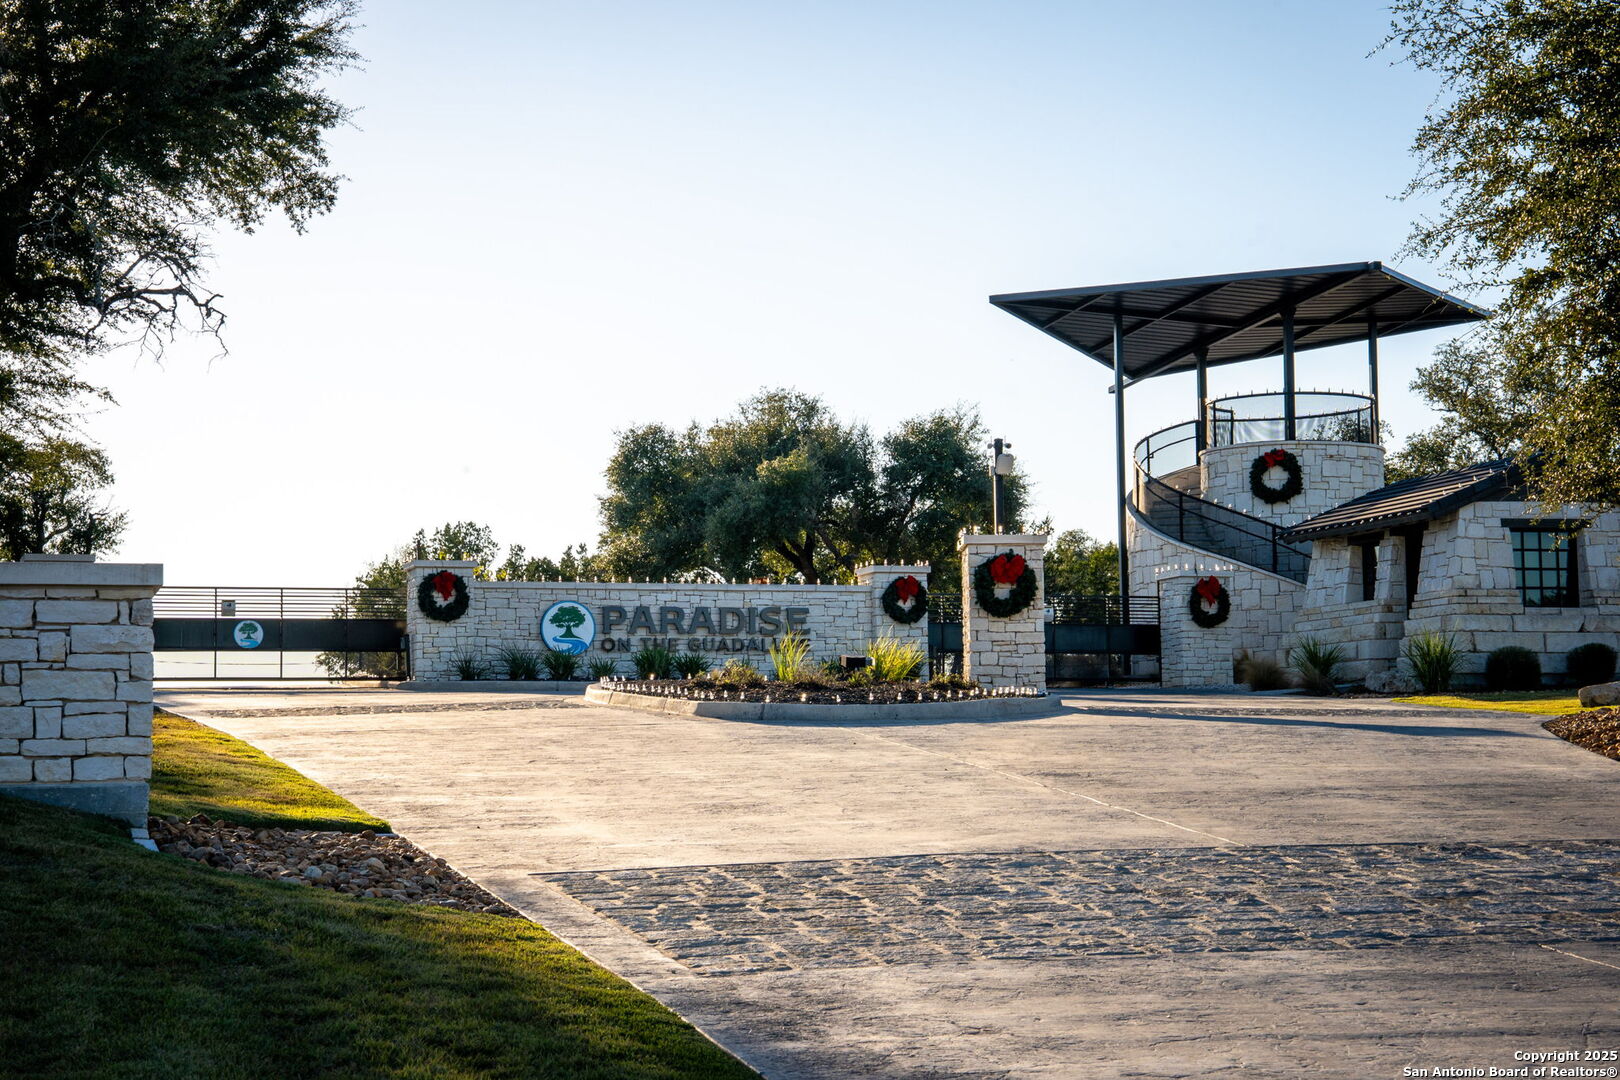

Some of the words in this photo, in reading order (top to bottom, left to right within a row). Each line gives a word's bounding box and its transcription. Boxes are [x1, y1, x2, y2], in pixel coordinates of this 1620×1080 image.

[601, 604, 811, 635] PARADISE
[600, 637, 632, 653] ON
[640, 638, 679, 653] THE
[688, 637, 812, 653] GUADAL
